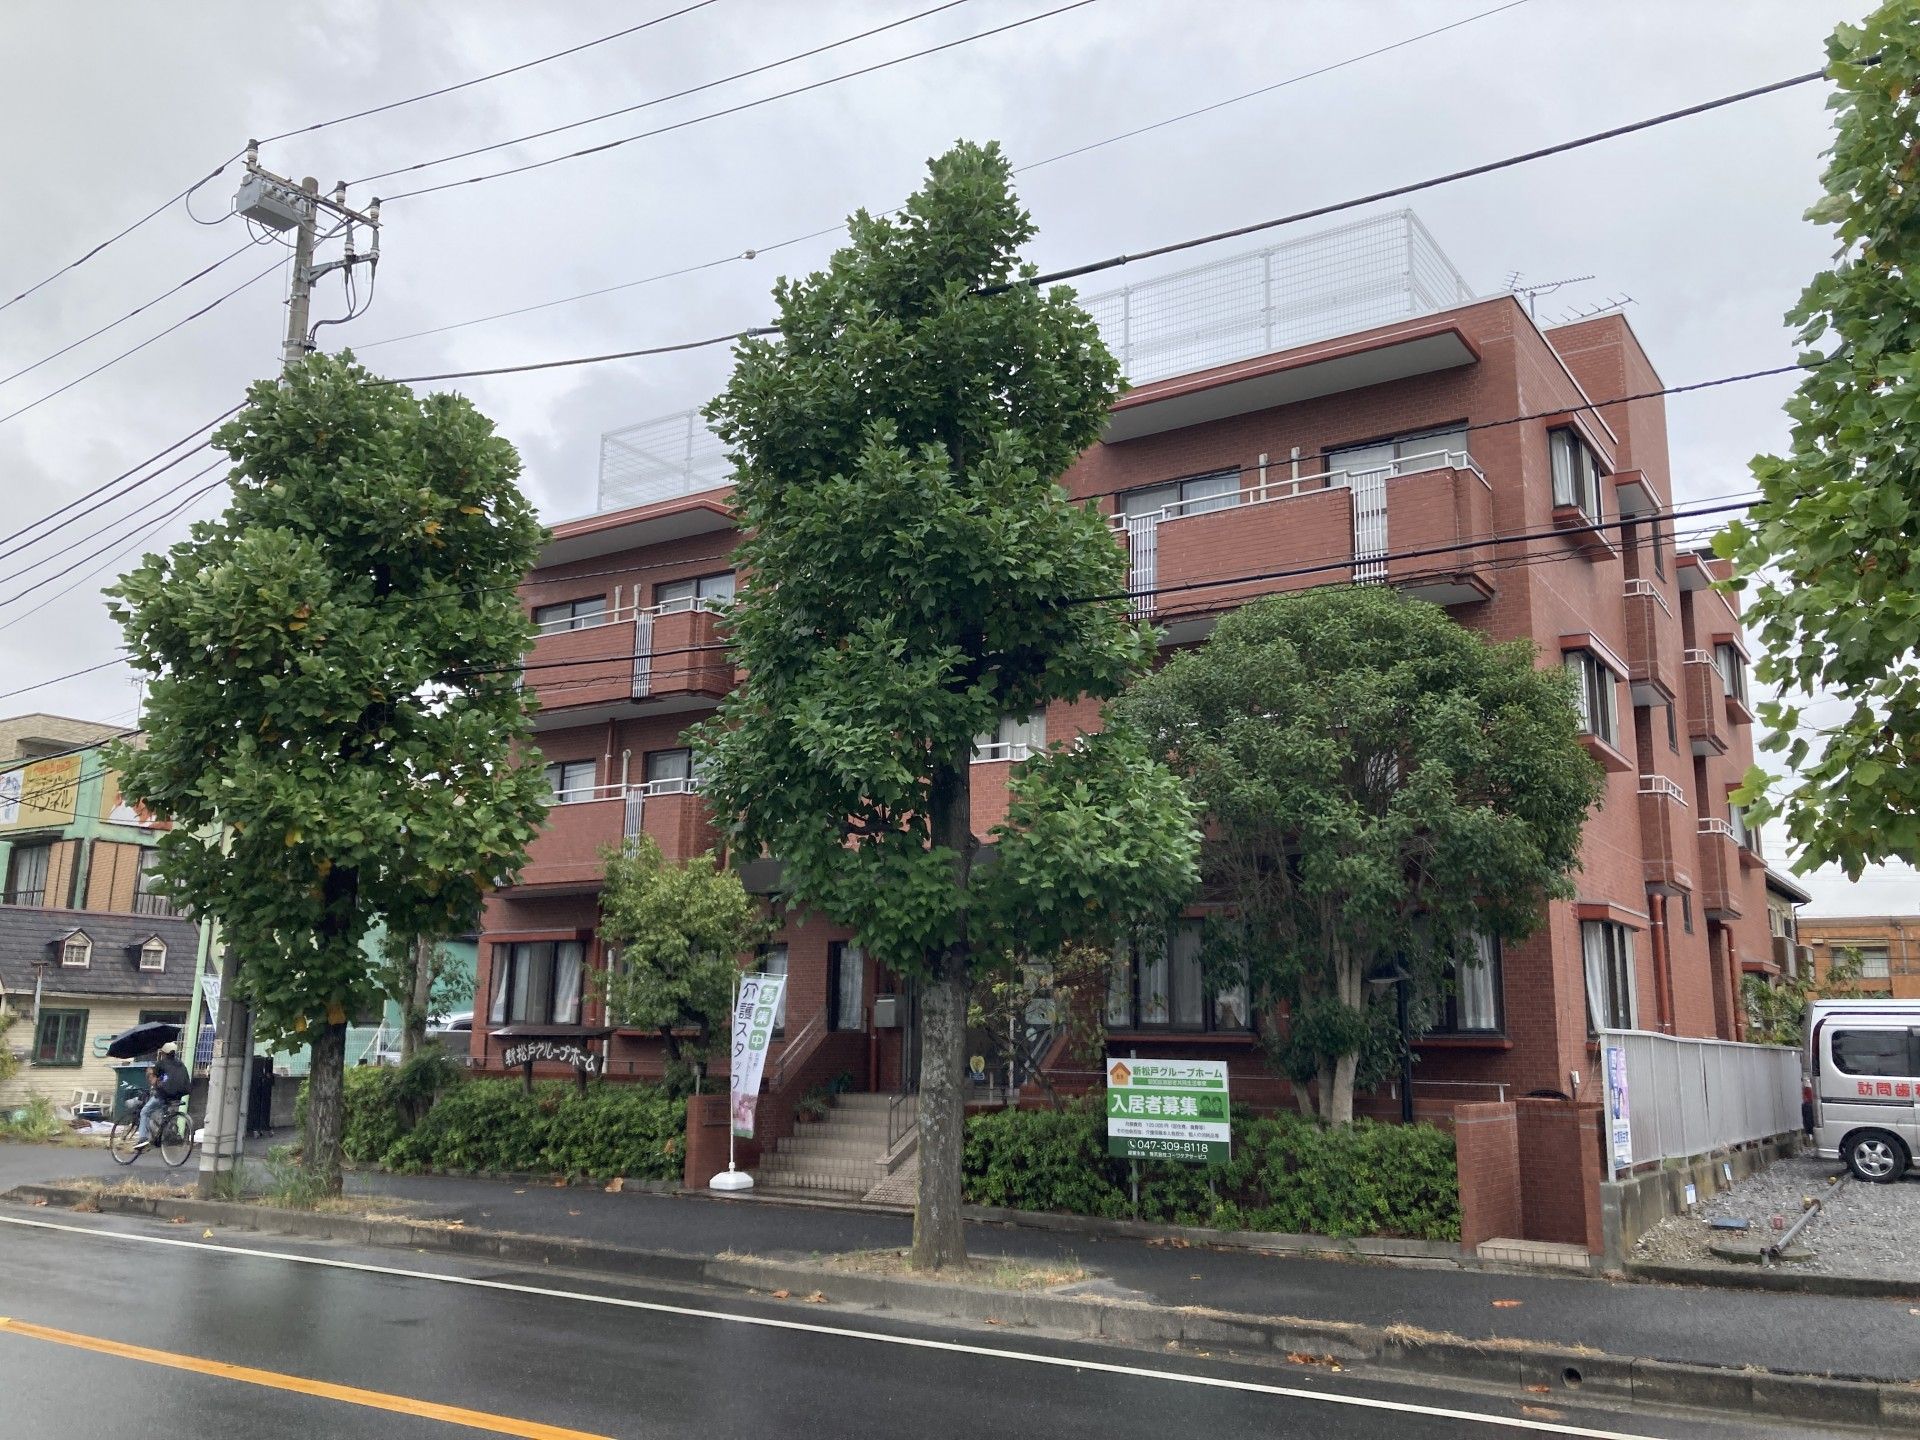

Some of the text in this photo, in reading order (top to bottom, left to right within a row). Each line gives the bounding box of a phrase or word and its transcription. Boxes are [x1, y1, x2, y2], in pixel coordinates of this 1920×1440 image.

[732, 982, 759, 1090] 介護スタッフ
[1111, 1094, 1198, 1116] 入居者募集
[1137, 1140, 1209, 1153] 047-309-8118
